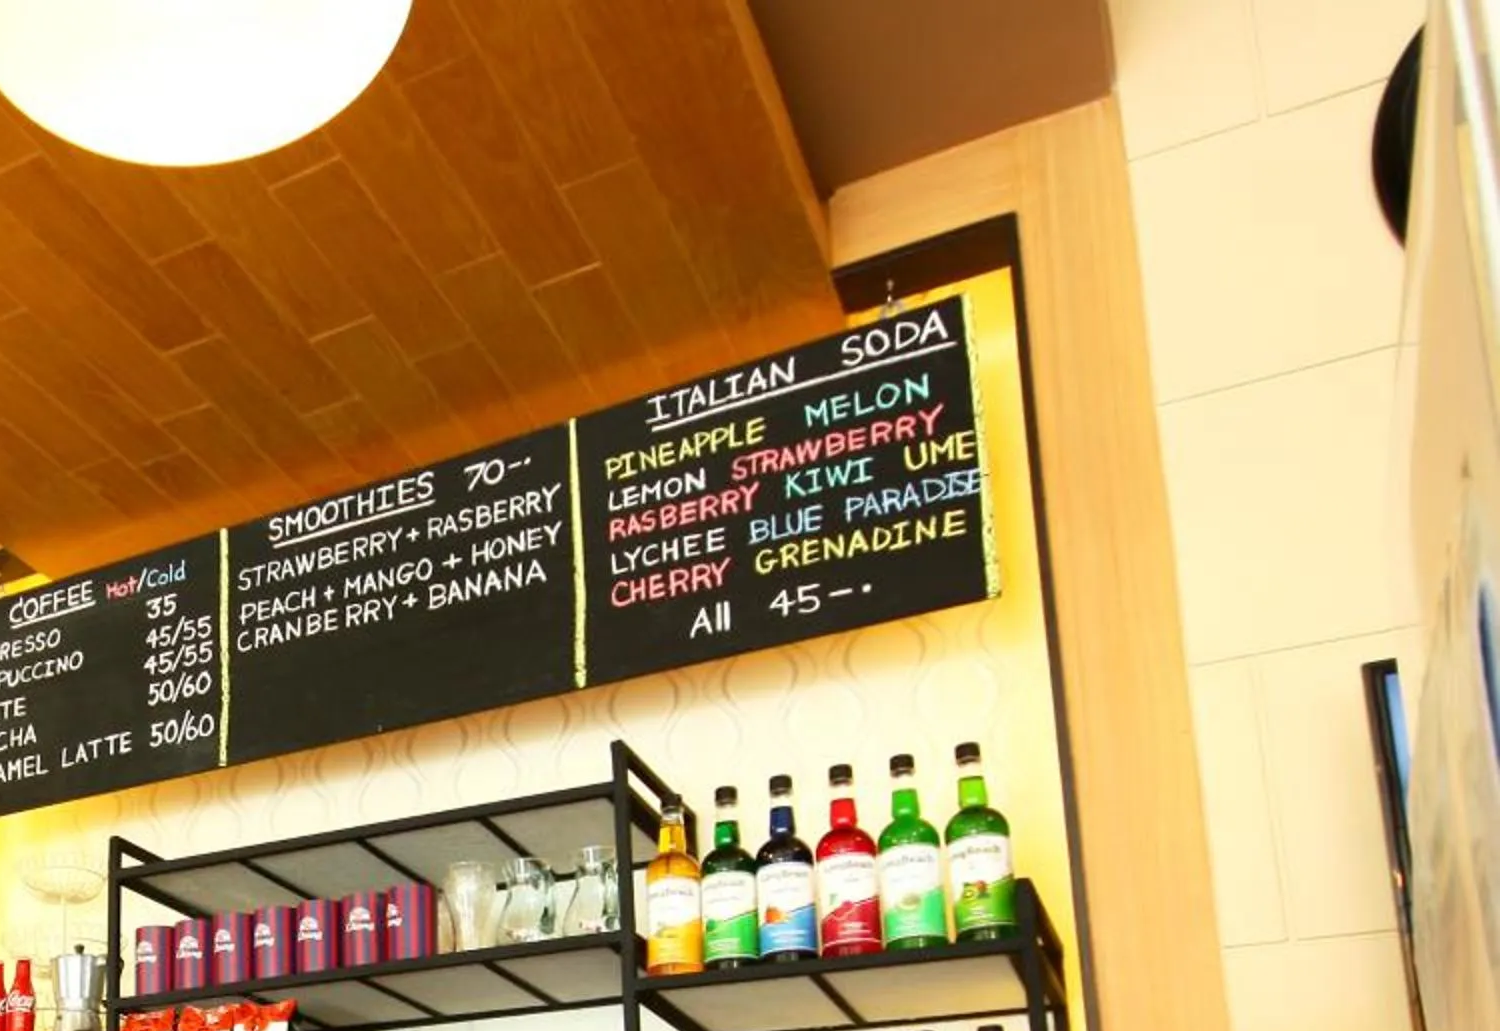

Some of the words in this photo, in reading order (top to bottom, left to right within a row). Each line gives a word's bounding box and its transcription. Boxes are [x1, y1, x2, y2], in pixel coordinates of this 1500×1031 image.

[646, 356, 796, 424] ITALIAN
[841, 309, 949, 366] SODA
[605, 417, 768, 481] PINEAPPLE
[805, 373, 930, 427] MELON
[609, 468, 707, 512] LEMON
[731, 403, 946, 481] STRAWBERRY
[268, 471, 435, 542] SMOOTHIES
[609, 482, 761, 542] RASBERRY
[784, 458, 874, 500] KIWI
[904, 430, 976, 472] UME
[611, 528, 727, 575] LYCHEE
[748, 505, 824, 546] BLUE
[845, 469, 983, 523] PARADISE
[237, 526, 404, 592] STRAWBERRY
[427, 483, 563, 539] RASBERRY
[239, 586, 316, 625] PEACH
[344, 558, 433, 599] MANGO
[471, 521, 563, 566] HONEY
[611, 557, 731, 608] CHERRY
[755, 510, 967, 575] GRENADINE
[9, 580, 94, 624] COFFEE
[145, 615, 212, 649] 45/55
[146, 593, 178, 619] 35
[237, 595, 399, 653] CRANBERRY
[427, 559, 548, 610] BANANA
[690, 601, 732, 639] All
[143, 641, 213, 675] 45/55
[147, 671, 212, 706] 50/60
[61, 731, 132, 768] LATTE
[149, 710, 214, 748] 50/60
